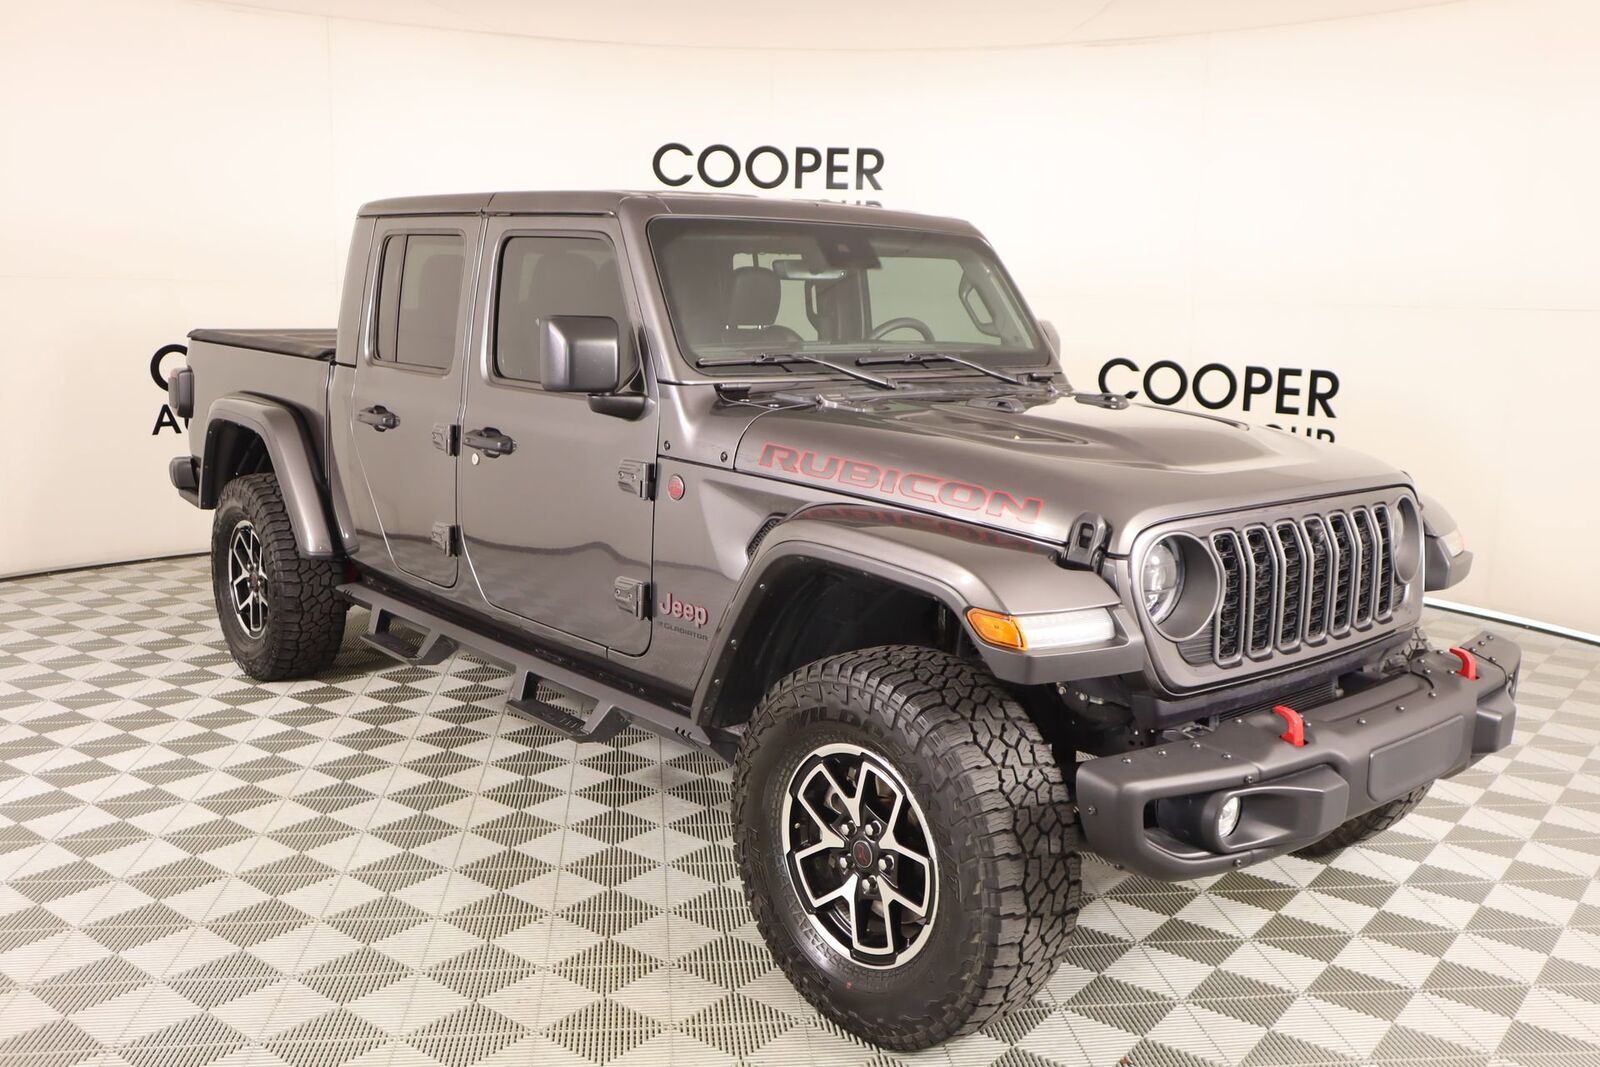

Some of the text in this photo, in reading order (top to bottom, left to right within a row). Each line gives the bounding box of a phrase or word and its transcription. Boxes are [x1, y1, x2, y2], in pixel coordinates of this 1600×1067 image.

[652, 142, 885, 191] COOPER
[1098, 357, 1340, 419] COOPER
[758, 443, 1045, 523] RUBICON
[660, 592, 708, 629] Jeep
[663, 621, 708, 641] GLADIATOR
